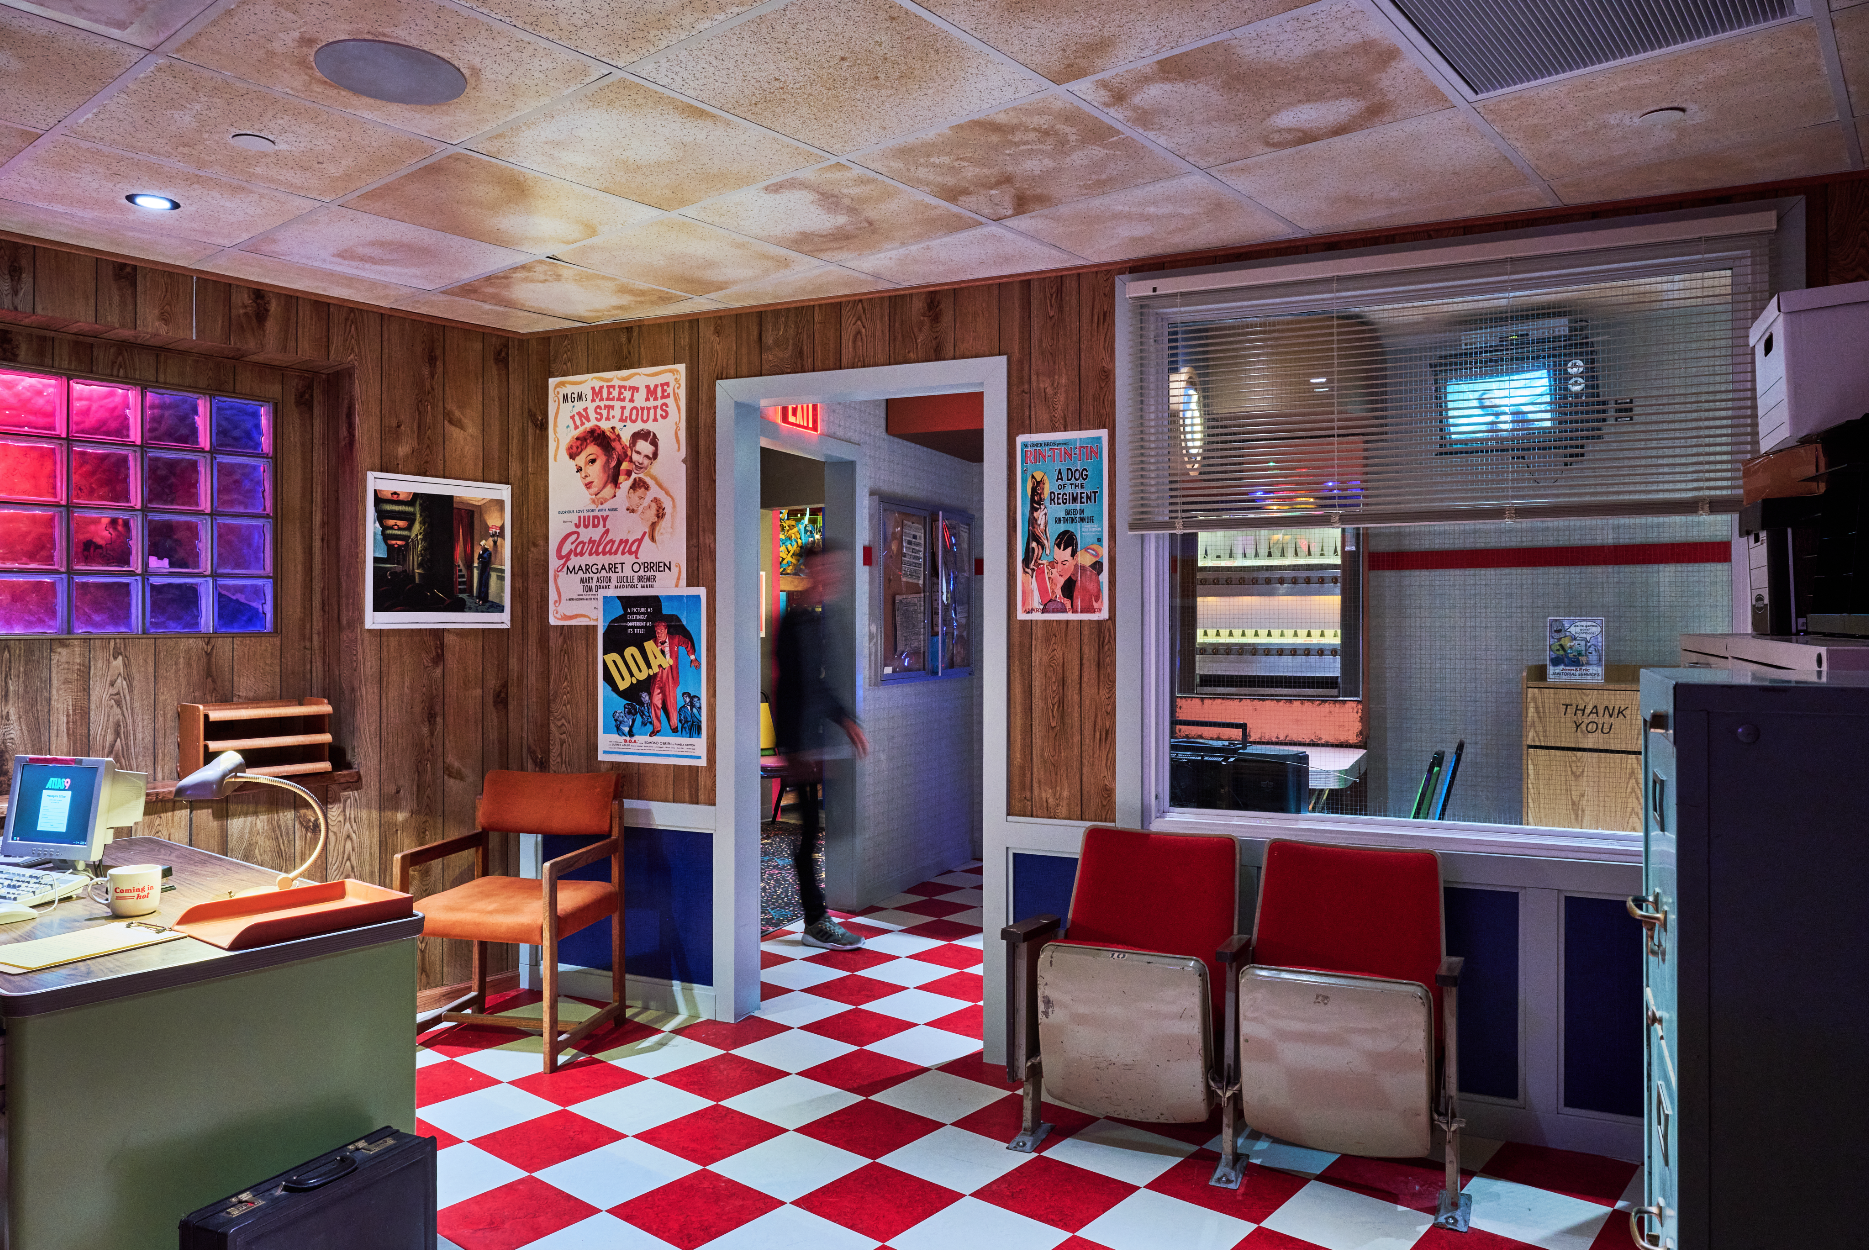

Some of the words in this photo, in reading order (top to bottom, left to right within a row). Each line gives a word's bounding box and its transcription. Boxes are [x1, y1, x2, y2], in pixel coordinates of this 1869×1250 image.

[590, 384, 640, 403] MEET
[645, 382, 670, 402] ME
[570, 406, 591, 431] IN
[594, 404, 616, 422] ST.
[618, 402, 669, 424] LOUIS
[1024, 444, 1099, 464] RIN-TIN-TIN
[1066, 468, 1088, 482] DOG
[574, 515, 610, 529] JUDY
[556, 528, 647, 573] Garland
[566, 562, 625, 575] MARGARET
[631, 561, 672, 573] O'BRIEN
[580, 576, 594, 584] MARY
[596, 576, 612, 584] ASTOR
[616, 576, 634, 584] LUCILLE
[637, 574, 656, 583] BREMER
[582, 584, 594, 592] TOM
[603, 640, 674, 691] D.O.A.
[1562, 704, 1629, 718] THANK
[1574, 720, 1613, 734] YOU
[136, 892, 150, 900] hot
